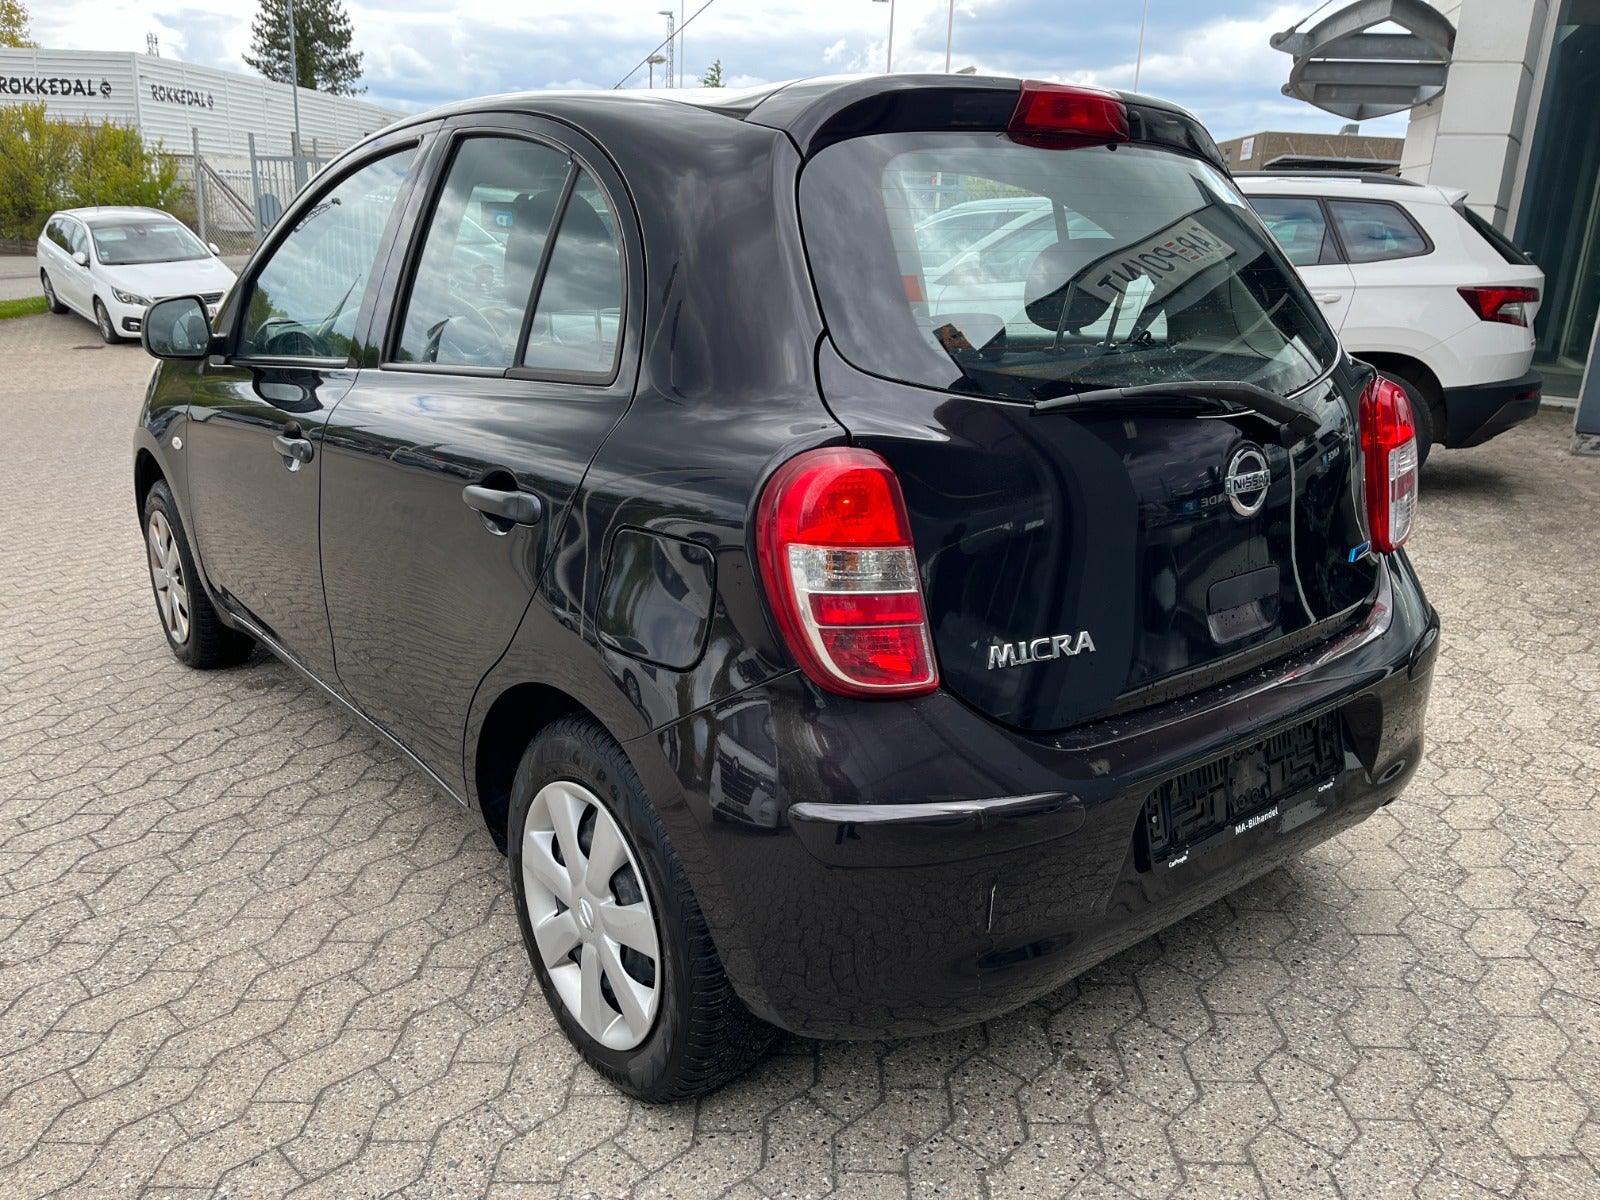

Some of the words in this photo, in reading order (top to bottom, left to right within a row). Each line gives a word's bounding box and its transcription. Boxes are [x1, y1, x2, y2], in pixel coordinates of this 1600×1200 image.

[0, 76, 97, 96] ROKKEDAL
[151, 84, 206, 107] ROKKEDAL
[1233, 471, 1269, 490] NISSAN
[988, 631, 1096, 670] MICRA
[1235, 807, 1278, 835] MA-Bilhandel
